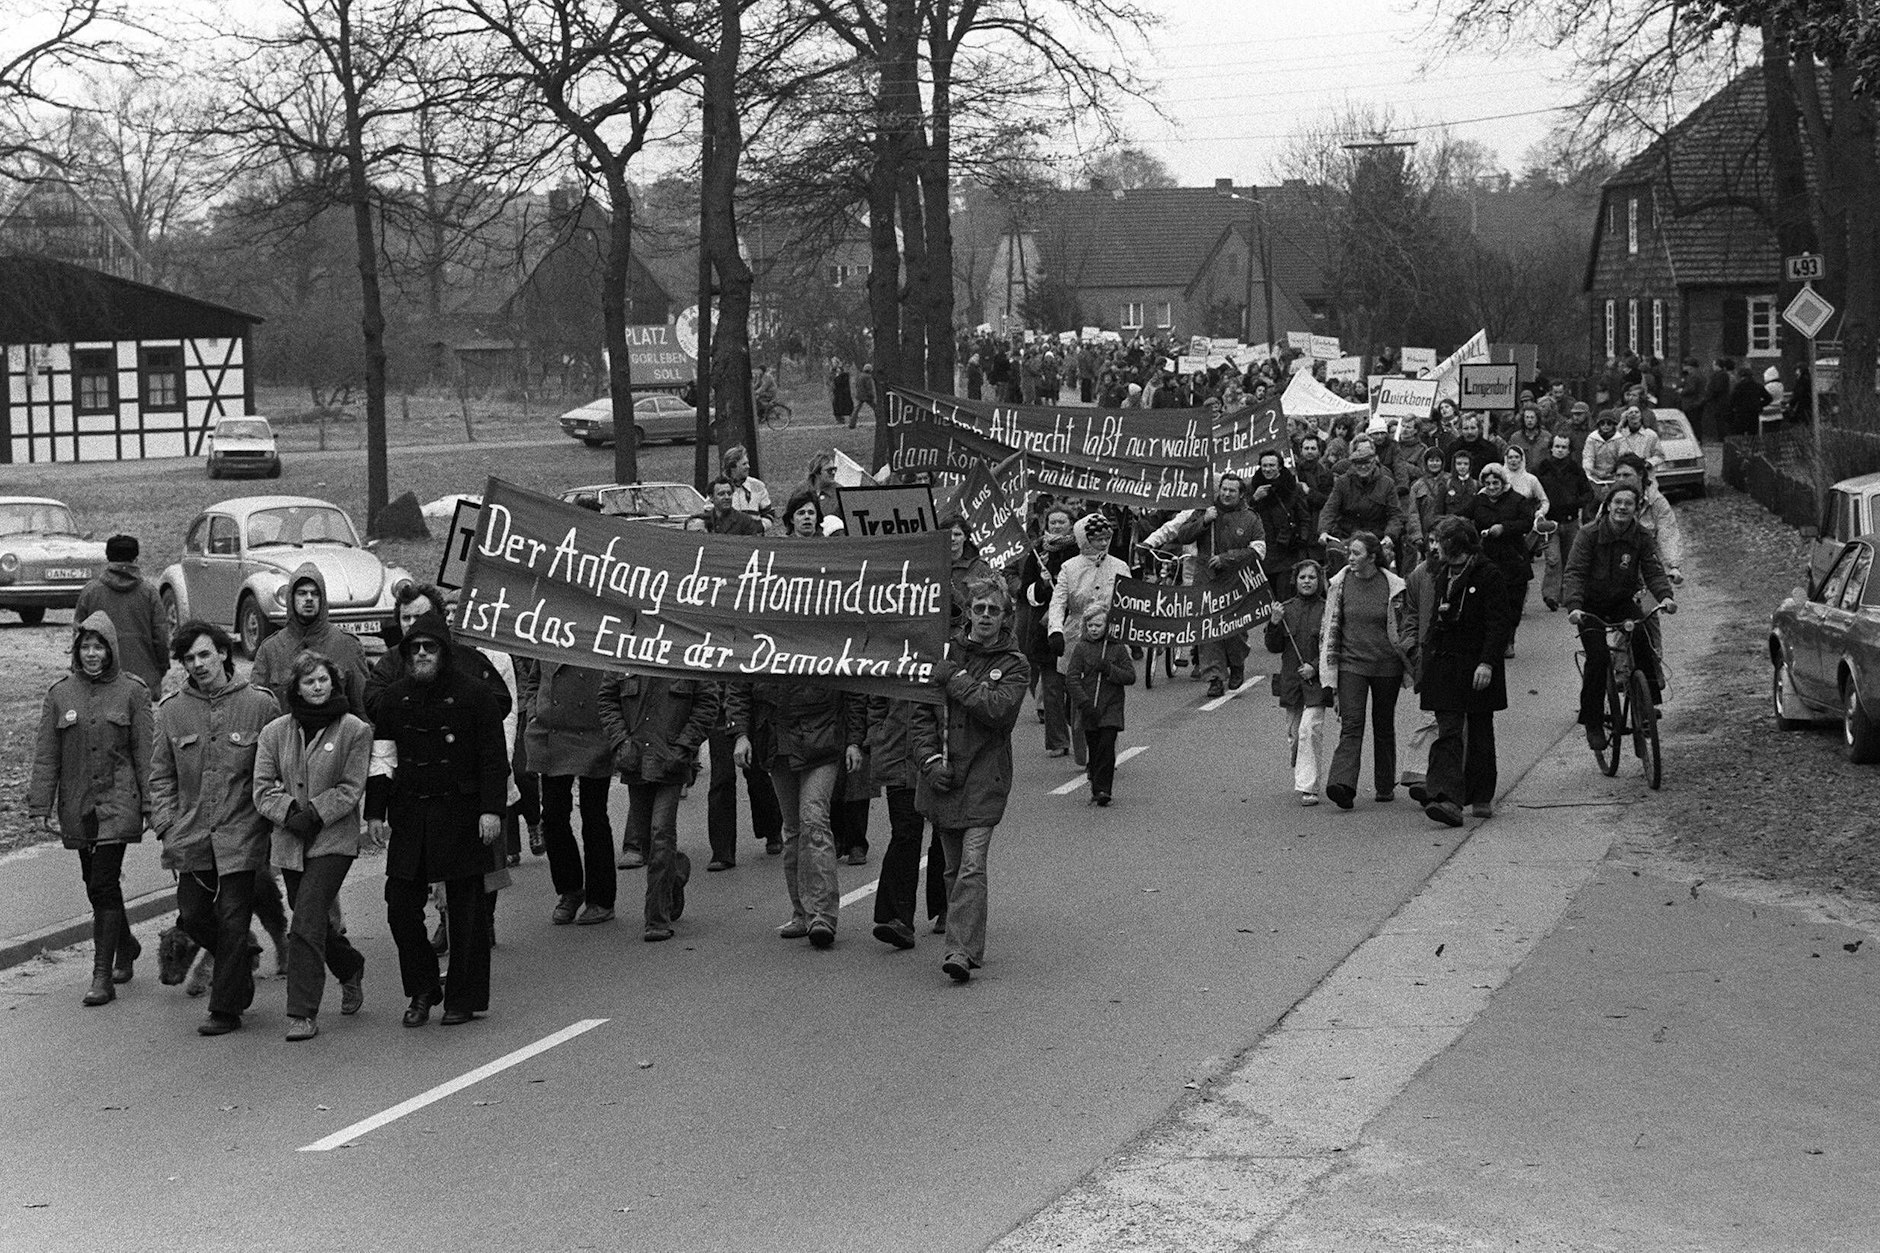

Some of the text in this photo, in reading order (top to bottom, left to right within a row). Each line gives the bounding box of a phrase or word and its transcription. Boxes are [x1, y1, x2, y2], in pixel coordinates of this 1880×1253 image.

[1793, 259, 1818, 276] 493
[625, 327, 668, 346] PLATZ
[631, 353, 688, 363] GORLEBEN
[654, 369, 682, 379] SOLL
[1380, 389, 1432, 407] Quickborn
[989, 408, 1075, 454] Albrecht
[893, 432, 938, 471] dann
[1077, 466, 1101, 491] die
[992, 502, 1012, 529] das
[478, 504, 941, 615] Der Anfang der Atomindustrie
[1201, 590, 1232, 616] Meer
[462, 587, 511, 638] ist
[514, 598, 577, 648] das
[592, 614, 673, 665] Ende
[683, 632, 734, 668] der
[1128, 619, 1176, 645] besser
[1176, 621, 1196, 643] als
[1201, 611, 1253, 640] Plutonium
[1255, 601, 1272, 620] sin
